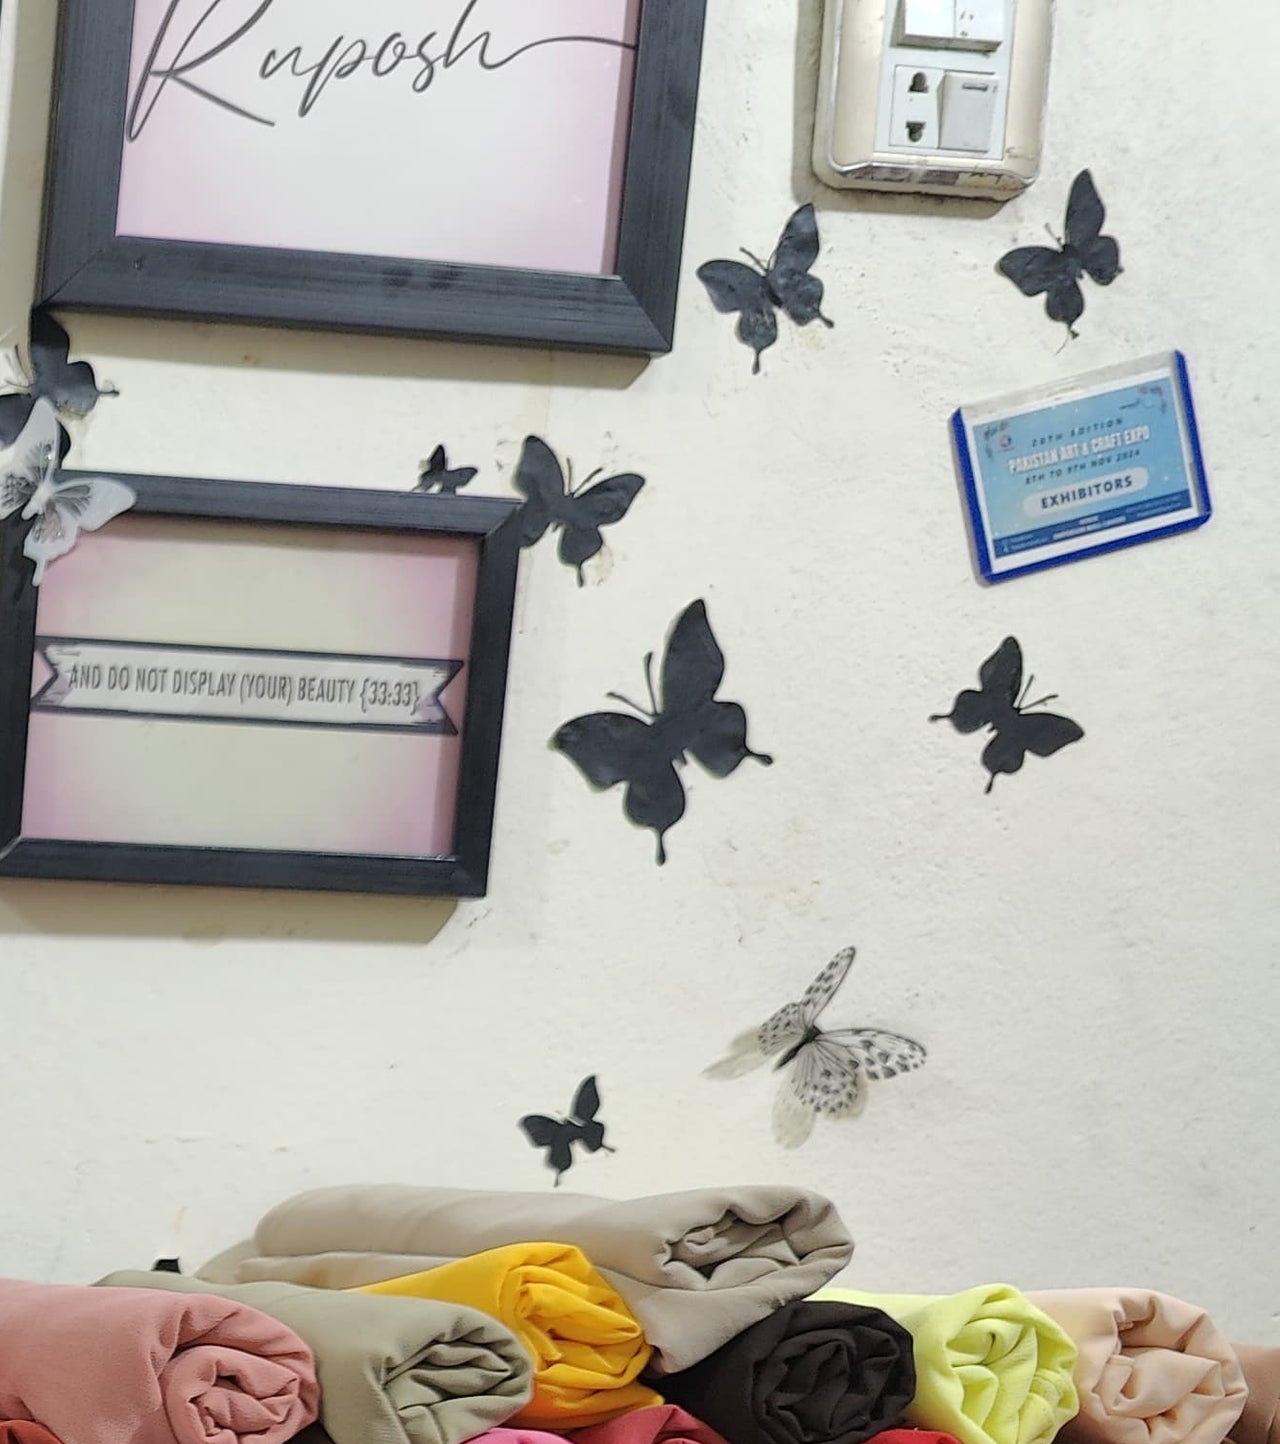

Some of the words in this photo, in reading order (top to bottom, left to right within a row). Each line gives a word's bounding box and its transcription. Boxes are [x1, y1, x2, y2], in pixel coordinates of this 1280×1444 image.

[1041, 475, 1133, 509] EXHIBITORS
[68, 663, 101, 689] AND
[107, 665, 130, 691] DO
[135, 667, 168, 693] NOT
[172, 669, 236, 697] DISPLAY
[240, 672, 292, 707] (YOUR)
[297, 677, 355, 704] BEAUTY
